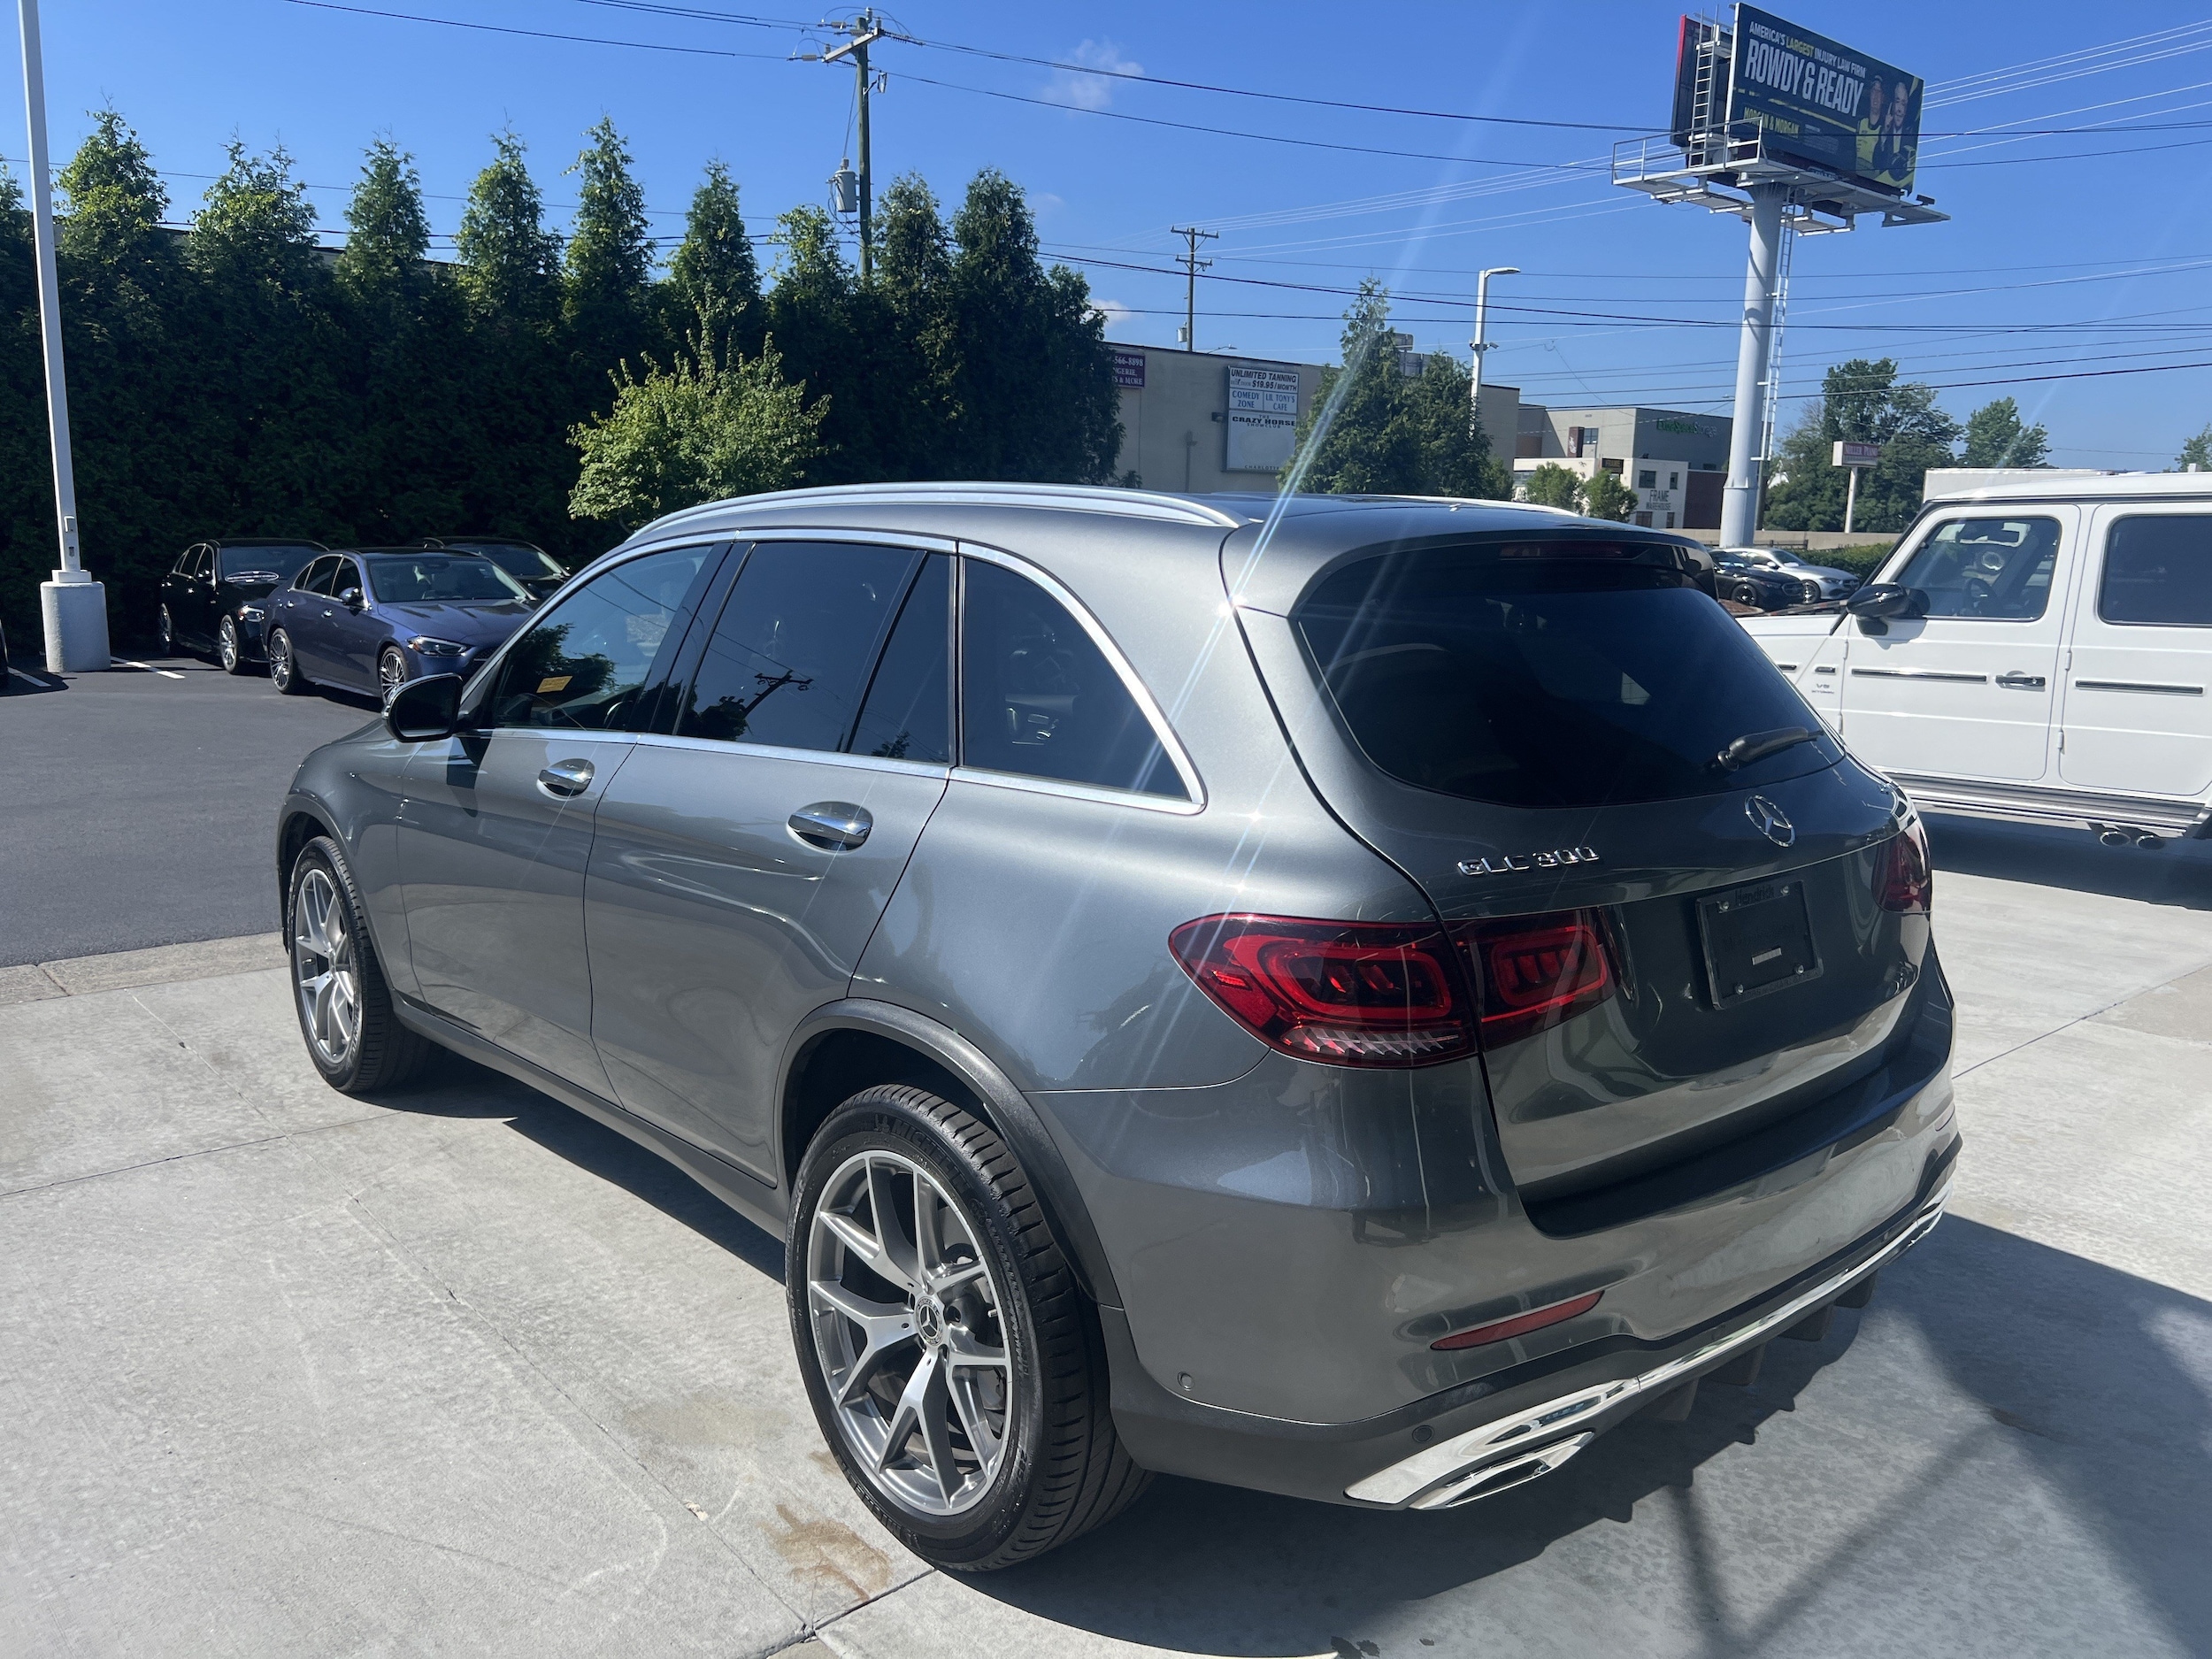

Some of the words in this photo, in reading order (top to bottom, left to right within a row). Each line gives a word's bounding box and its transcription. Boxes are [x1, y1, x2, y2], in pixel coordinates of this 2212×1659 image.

[1749, 21, 1786, 45] AMERICA'S
[1786, 35, 1815, 58] LARGEST
[1814, 47, 1838, 67] INJURY
[1837, 57, 1852, 73] LAW
[1850, 62, 1867, 78] FIRM
[1744, 38, 1805, 96] ROWDY
[1801, 61, 1816, 100] &
[1815, 65, 1864, 117] READY
[1231, 369, 1267, 380] UNLIMITED
[1269, 373, 1297, 383] TANNING
[1232, 390, 1260, 400] COMEDY
[1276, 394, 1295, 403] TONY'S
[1238, 399, 1255, 409] ZONE
[1272, 403, 1287, 411] CAFE
[1649, 489, 1670, 502] FRAME
[1456, 854, 1531, 876] GLC
[1531, 845, 1601, 868] 300
[891, 1118, 973, 1194] MICHELIN
